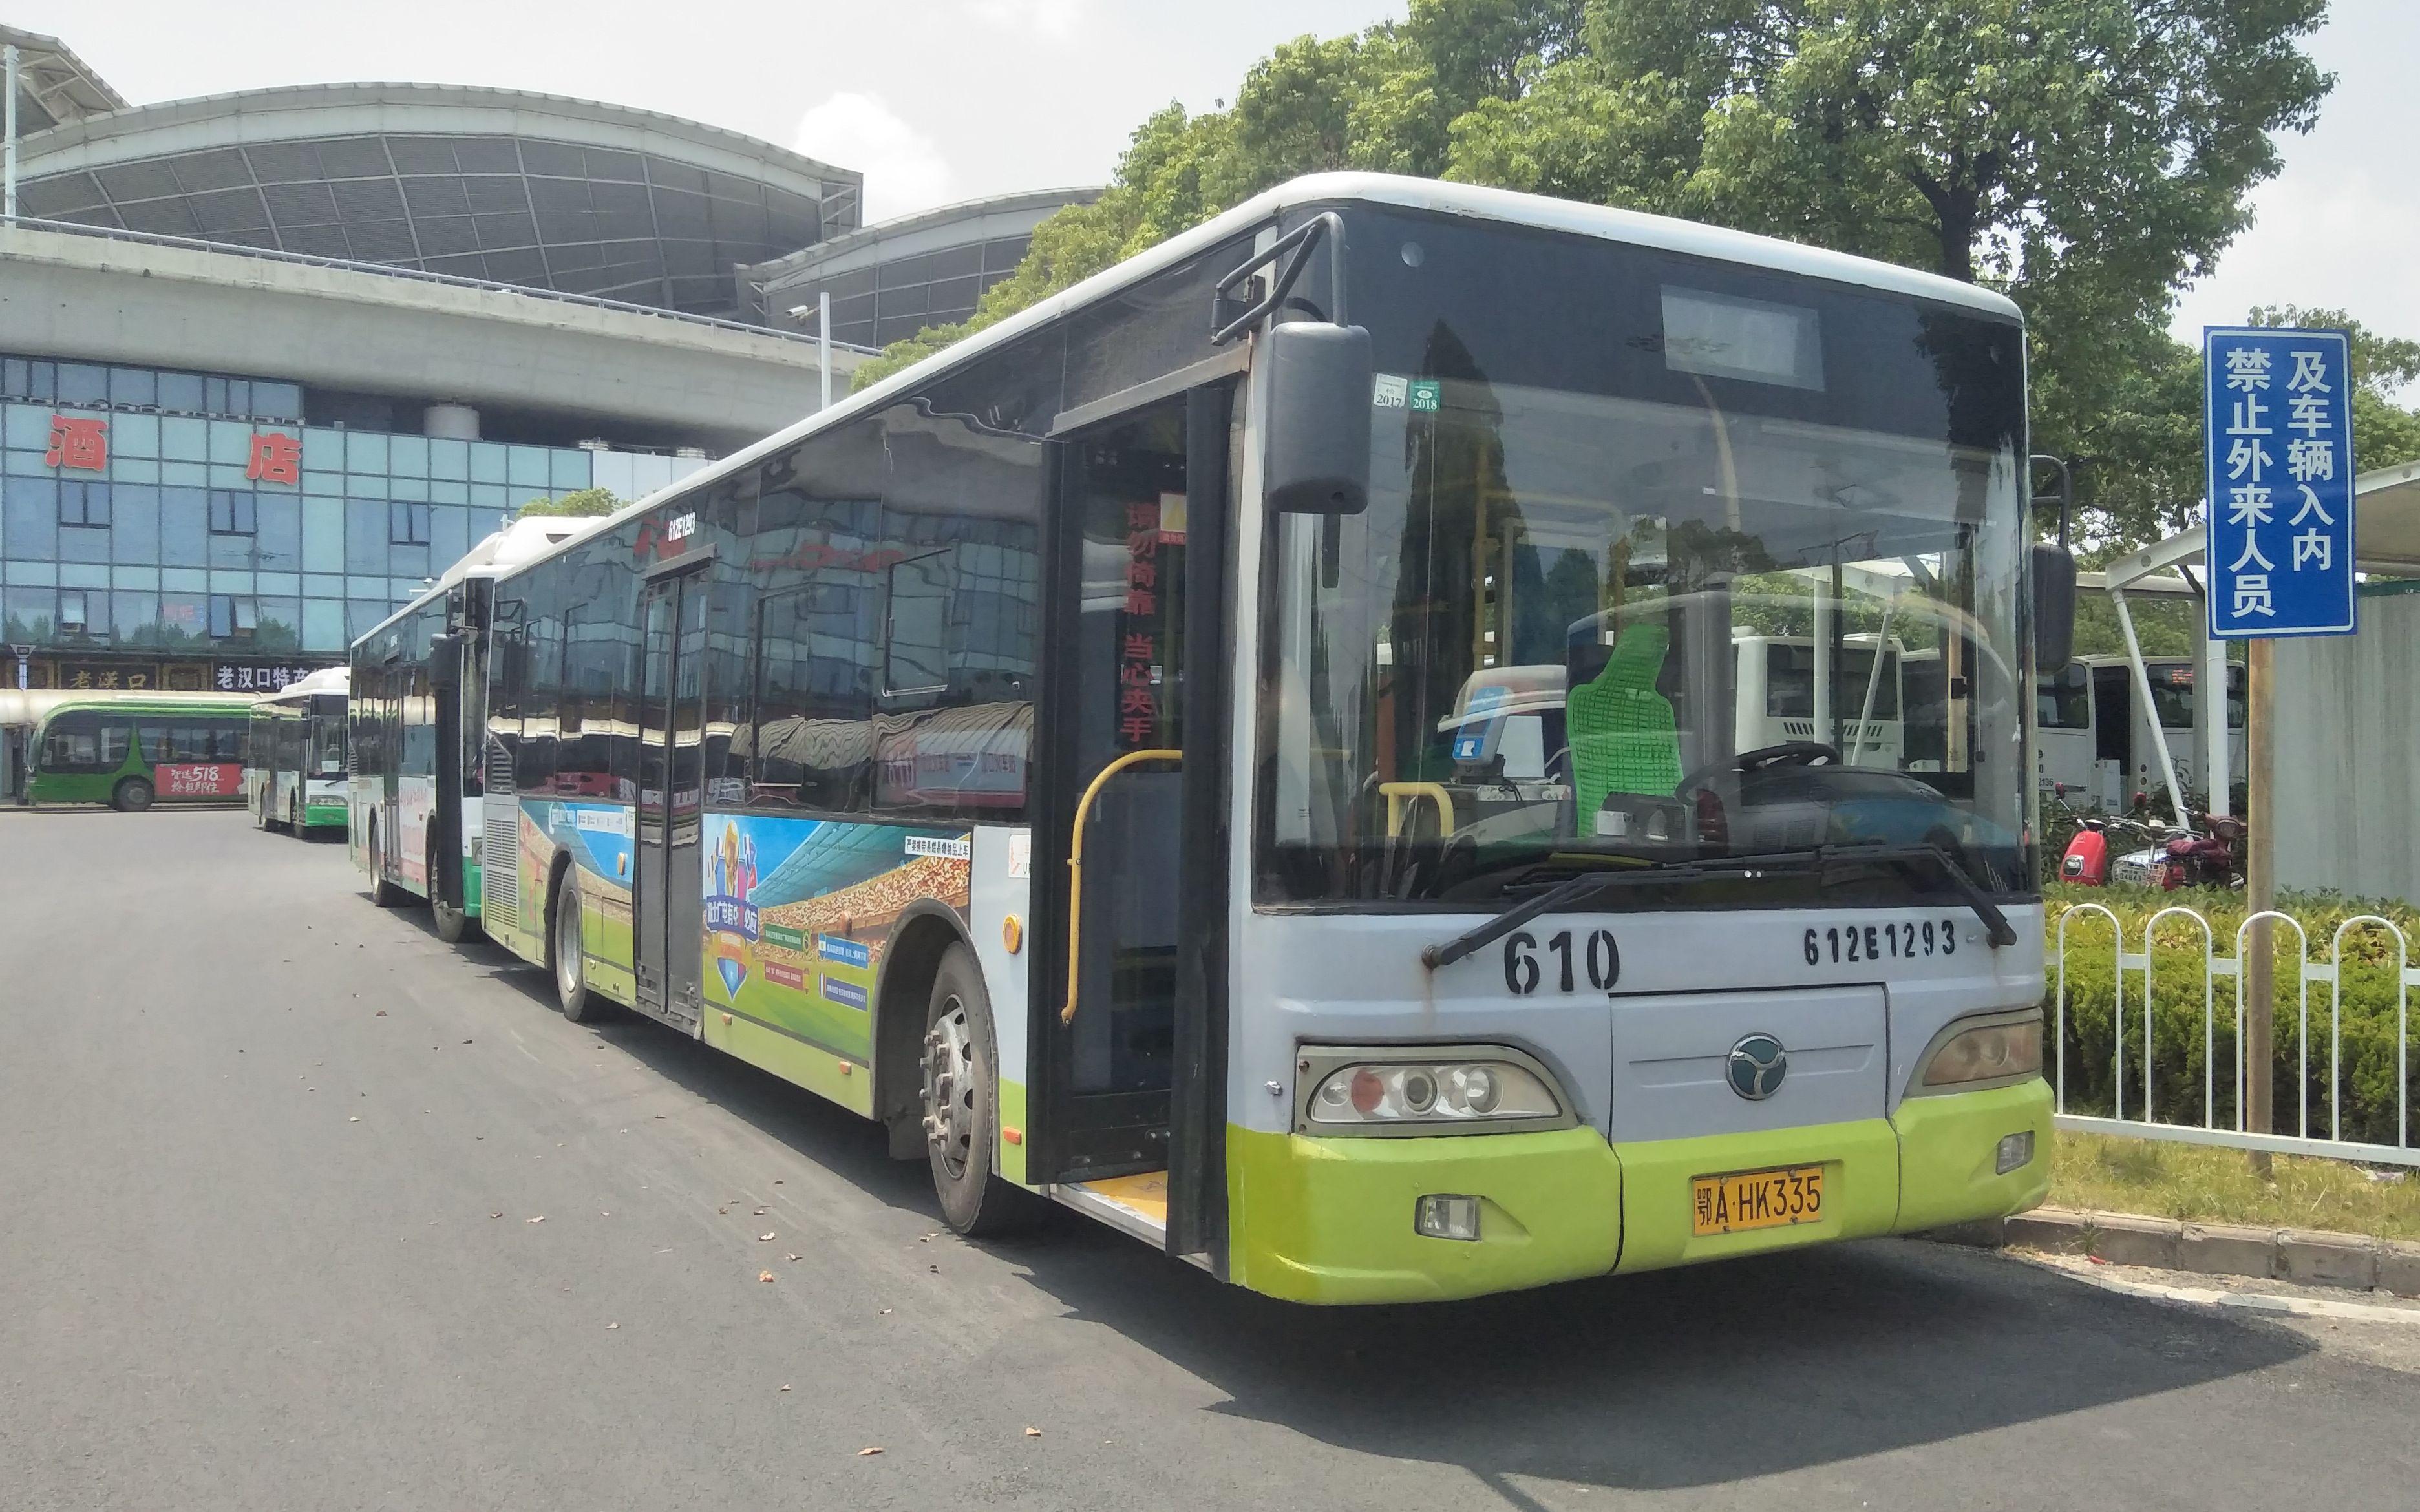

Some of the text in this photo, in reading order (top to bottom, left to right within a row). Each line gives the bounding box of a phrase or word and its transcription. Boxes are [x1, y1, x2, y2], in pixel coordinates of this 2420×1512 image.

[1376, 394, 1402, 407] 2017
[1412, 398, 1438, 410] 2018
[2225, 347, 2277, 618] 禁止外来人员
[2286, 350, 2335, 571] 及车辆入内
[668, 511, 696, 542] 612E1293
[217, 666, 322, 690] 老汉口特产
[1119, 633, 1158, 742] 当心夹手
[1503, 930, 1620, 995] 610
[1804, 920, 1956, 966] 612E1293
